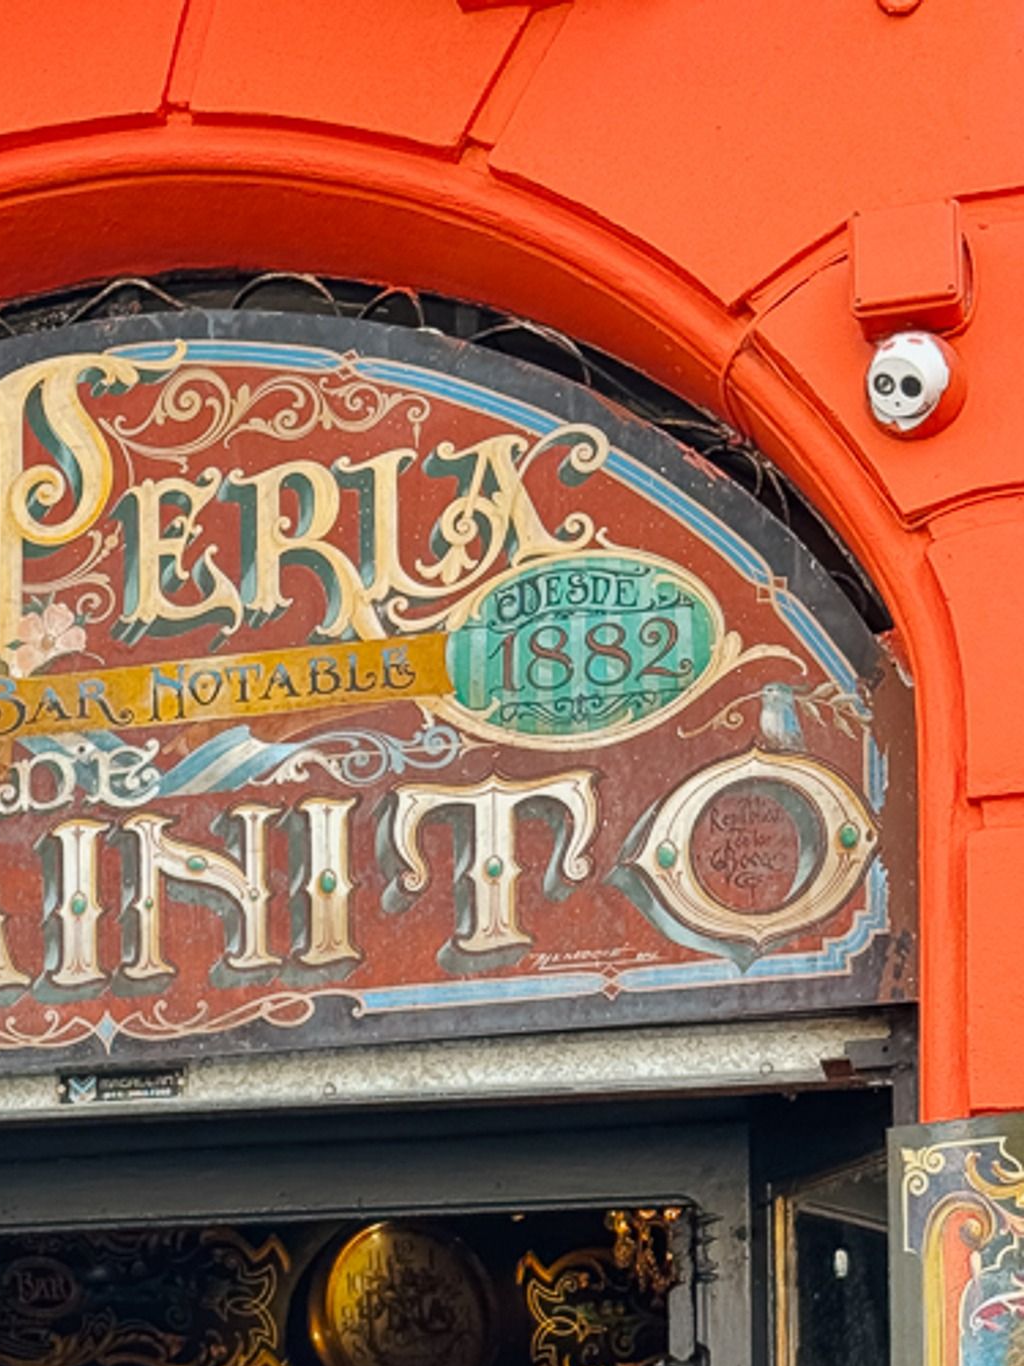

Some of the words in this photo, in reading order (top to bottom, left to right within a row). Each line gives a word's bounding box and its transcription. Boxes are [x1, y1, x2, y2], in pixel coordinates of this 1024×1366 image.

[495, 571, 640, 623] DESDE
[149, 644, 416, 721] NOTABLE
[488, 616, 694, 694] 1882
